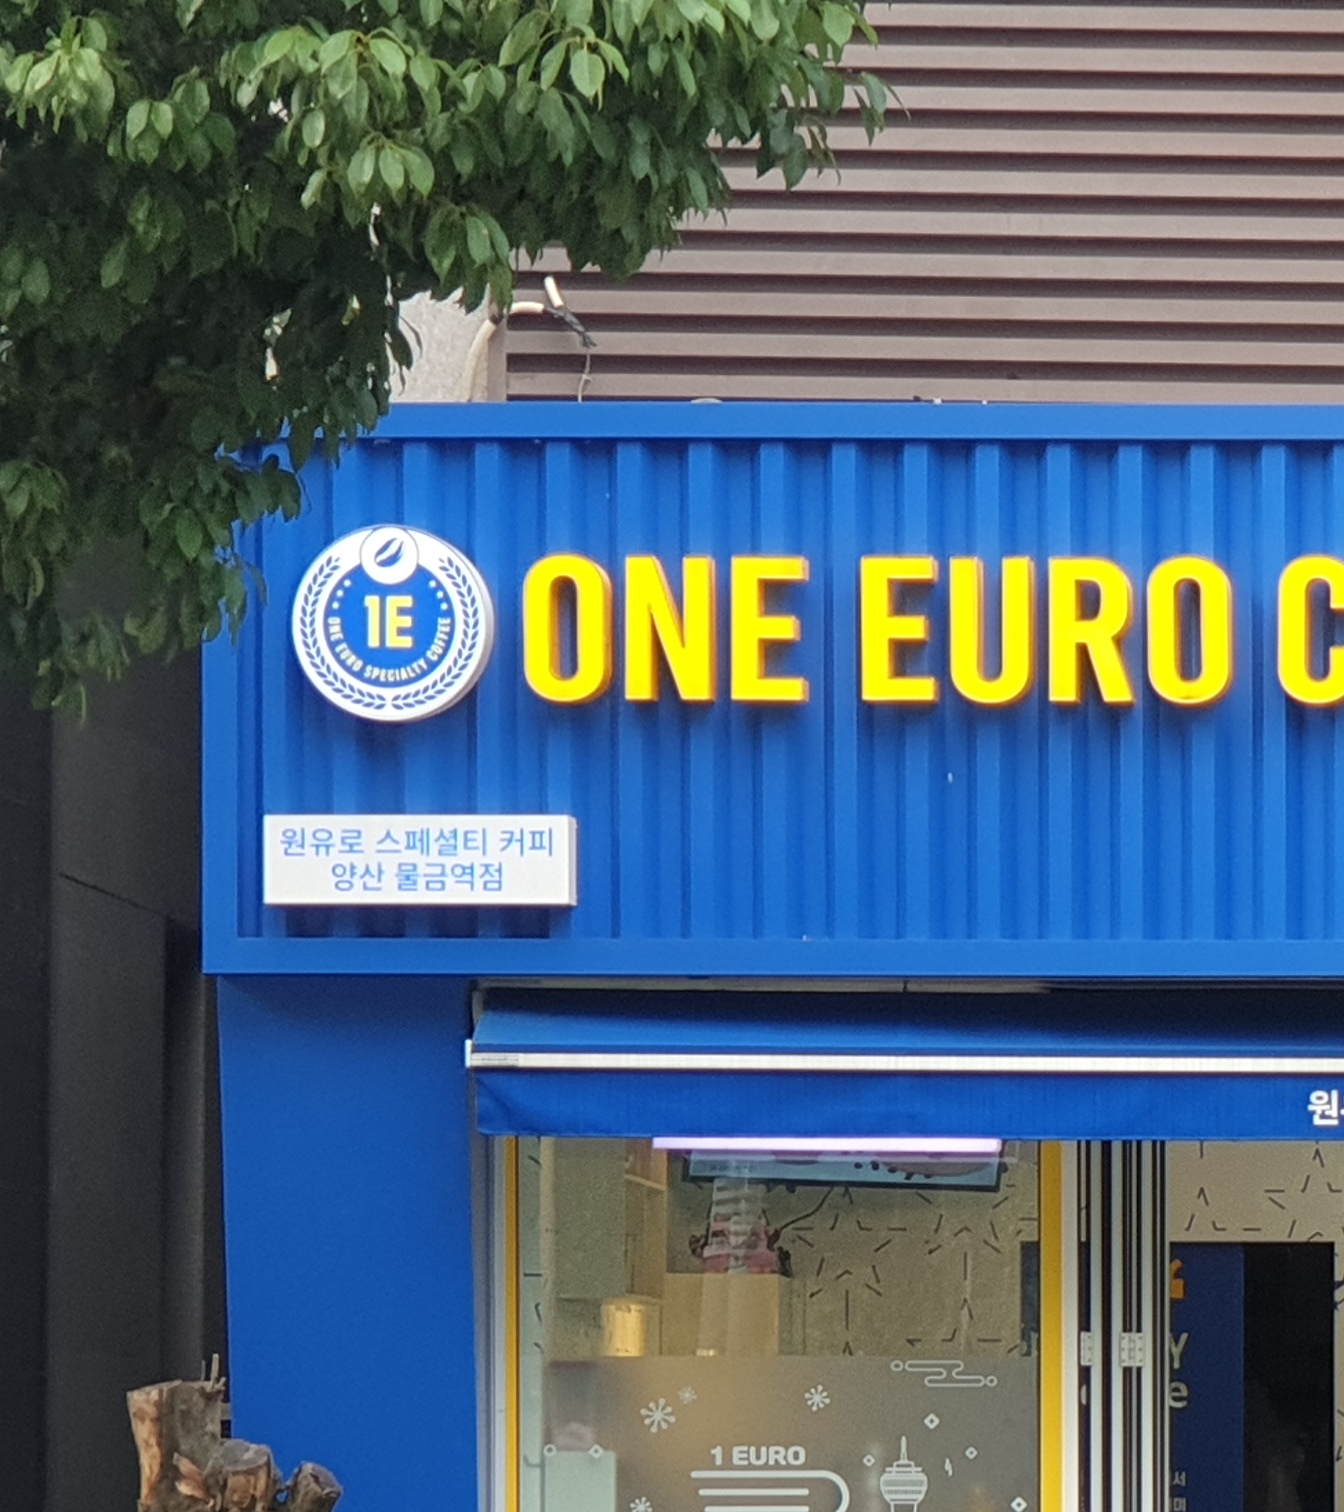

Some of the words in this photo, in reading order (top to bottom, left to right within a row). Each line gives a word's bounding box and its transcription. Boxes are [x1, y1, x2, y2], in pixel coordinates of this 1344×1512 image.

[364, 594, 413, 648] 1E
[521, 552, 808, 706] ONE
[860, 552, 1234, 708] EURO
[364, 658, 428, 683] SPECIALTY
[425, 616, 451, 661] COFFEE
[280, 826, 365, 857] 원유로
[375, 826, 488, 858] 스페셜티
[499, 826, 554, 858] 커피
[331, 861, 386, 892] 양산
[396, 861, 504, 892] 물금역점
[711, 1446, 723, 1466] 1
[732, 1445, 807, 1466] EURO
